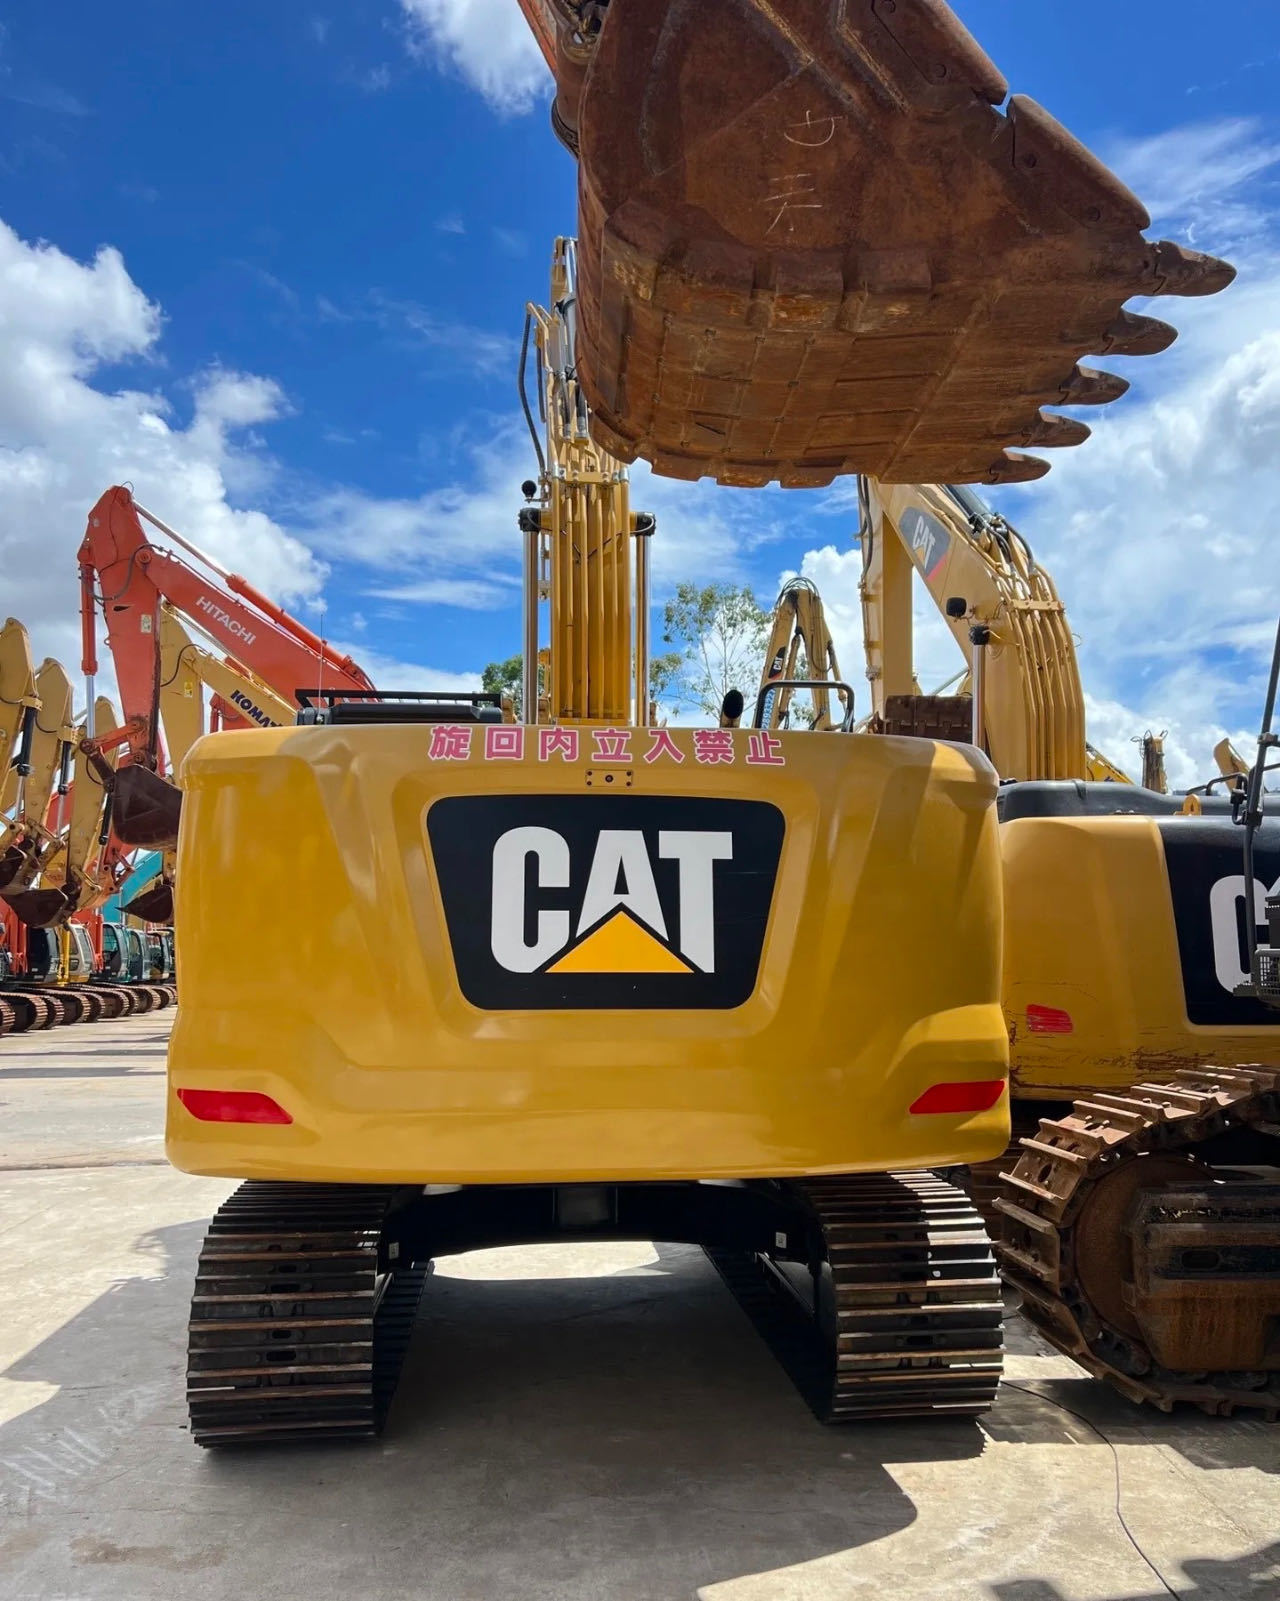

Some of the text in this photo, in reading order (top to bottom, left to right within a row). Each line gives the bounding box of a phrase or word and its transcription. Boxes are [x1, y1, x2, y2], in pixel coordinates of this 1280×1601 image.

[912, 515, 936, 569] CAT
[195, 596, 257, 645] HITACHI
[773, 656, 784, 671] CAT
[428, 725, 786, 766] 旋回内立入禁止
[490, 825, 734, 974] CAT
[1209, 874, 1280, 994] C
